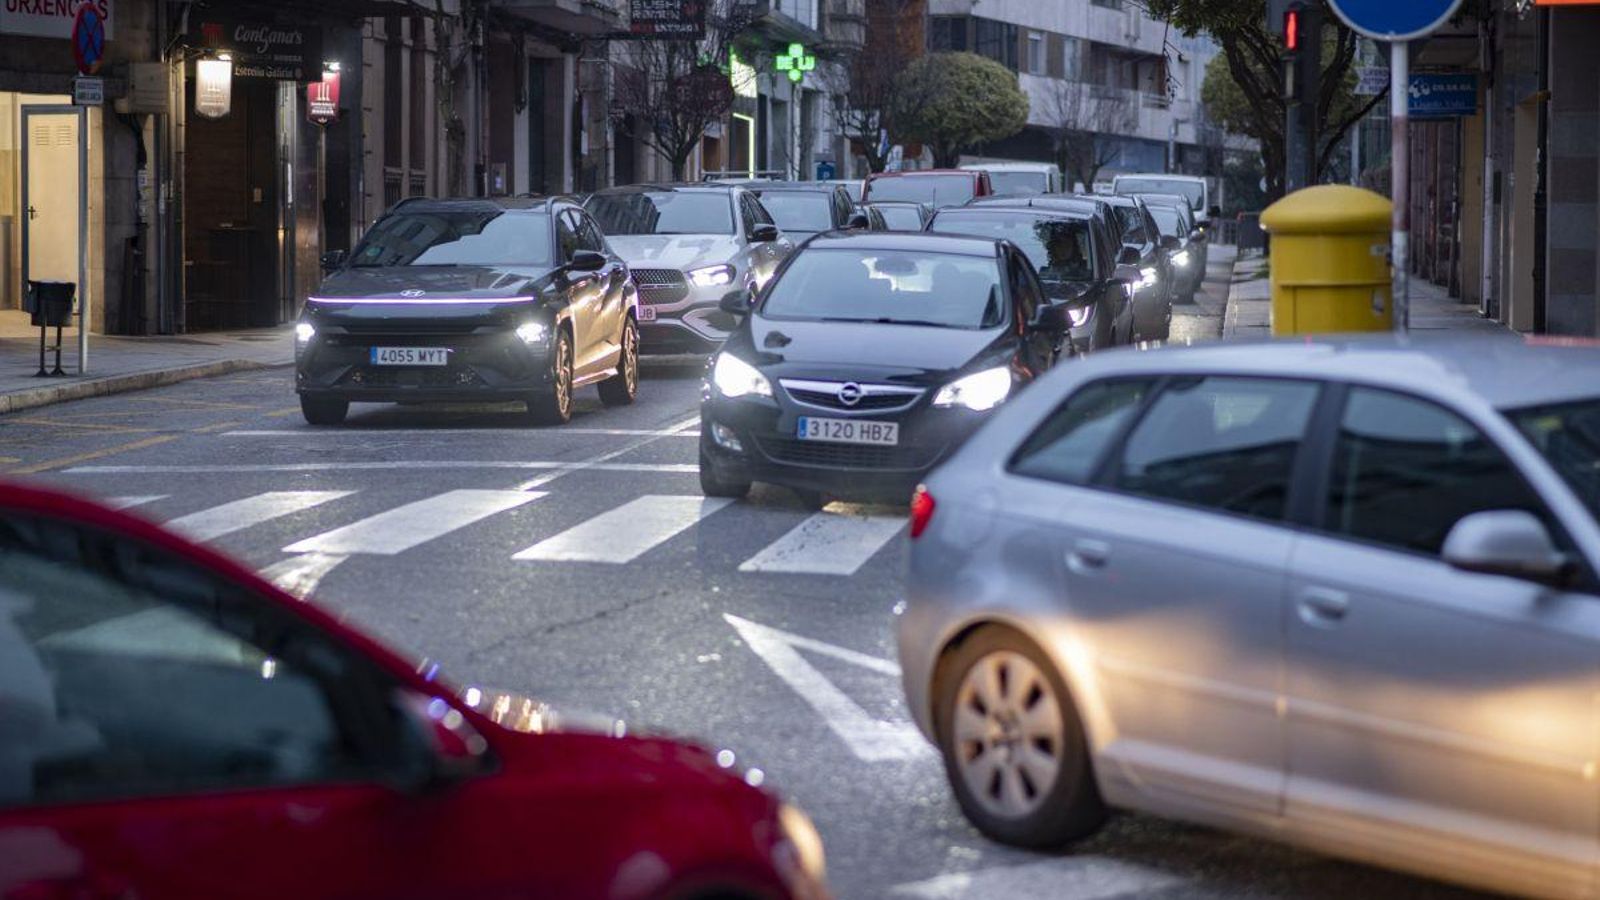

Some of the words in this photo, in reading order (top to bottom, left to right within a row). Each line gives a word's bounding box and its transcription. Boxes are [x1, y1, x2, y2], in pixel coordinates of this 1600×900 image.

[6, 0, 108, 20] URXENCS
[632, 0, 680, 9] SUSHI
[381, 350, 414, 362] 4055
[418, 350, 443, 362] MYT
[809, 421, 853, 438] 3120
[860, 424, 894, 441] HBZ
